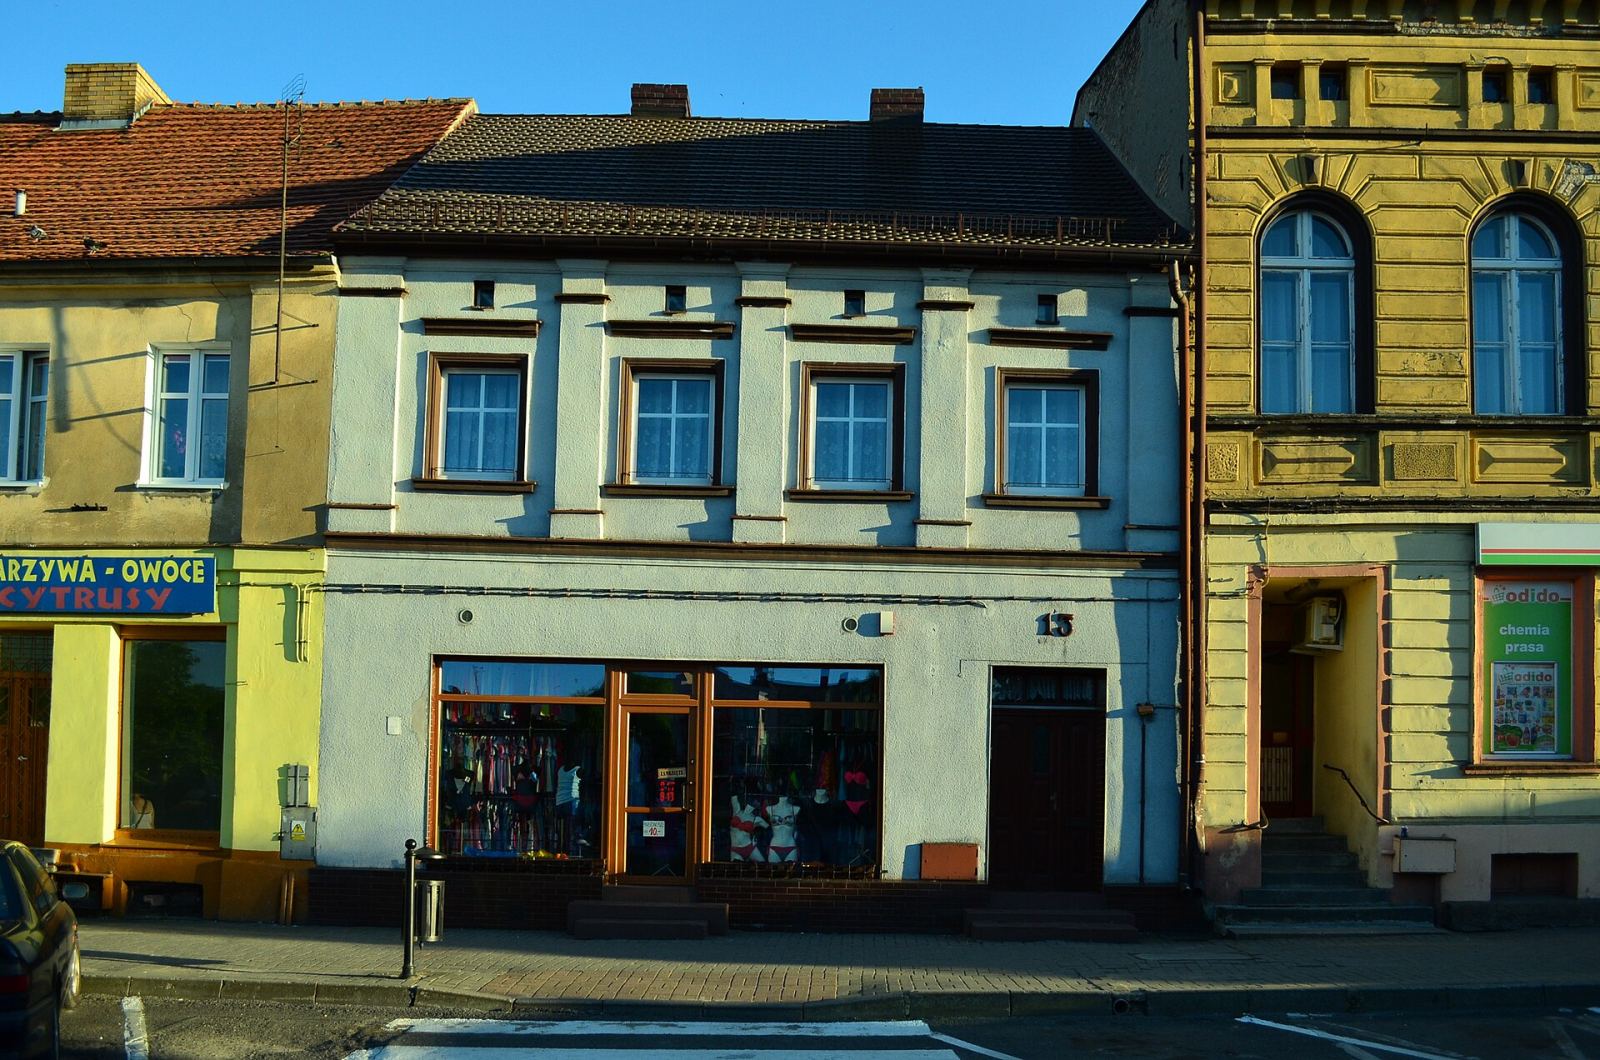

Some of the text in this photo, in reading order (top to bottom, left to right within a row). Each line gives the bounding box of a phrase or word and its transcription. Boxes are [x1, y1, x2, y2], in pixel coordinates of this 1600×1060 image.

[105, 567, 115, 575] -
[122, 559, 205, 583] OWOCE
[0, 585, 173, 610] CYTRUSY
[1505, 588, 1560, 602] odido
[1499, 624, 1550, 635] chemia
[1505, 642, 1544, 655] prasa
[1514, 671, 1552, 682] odido
